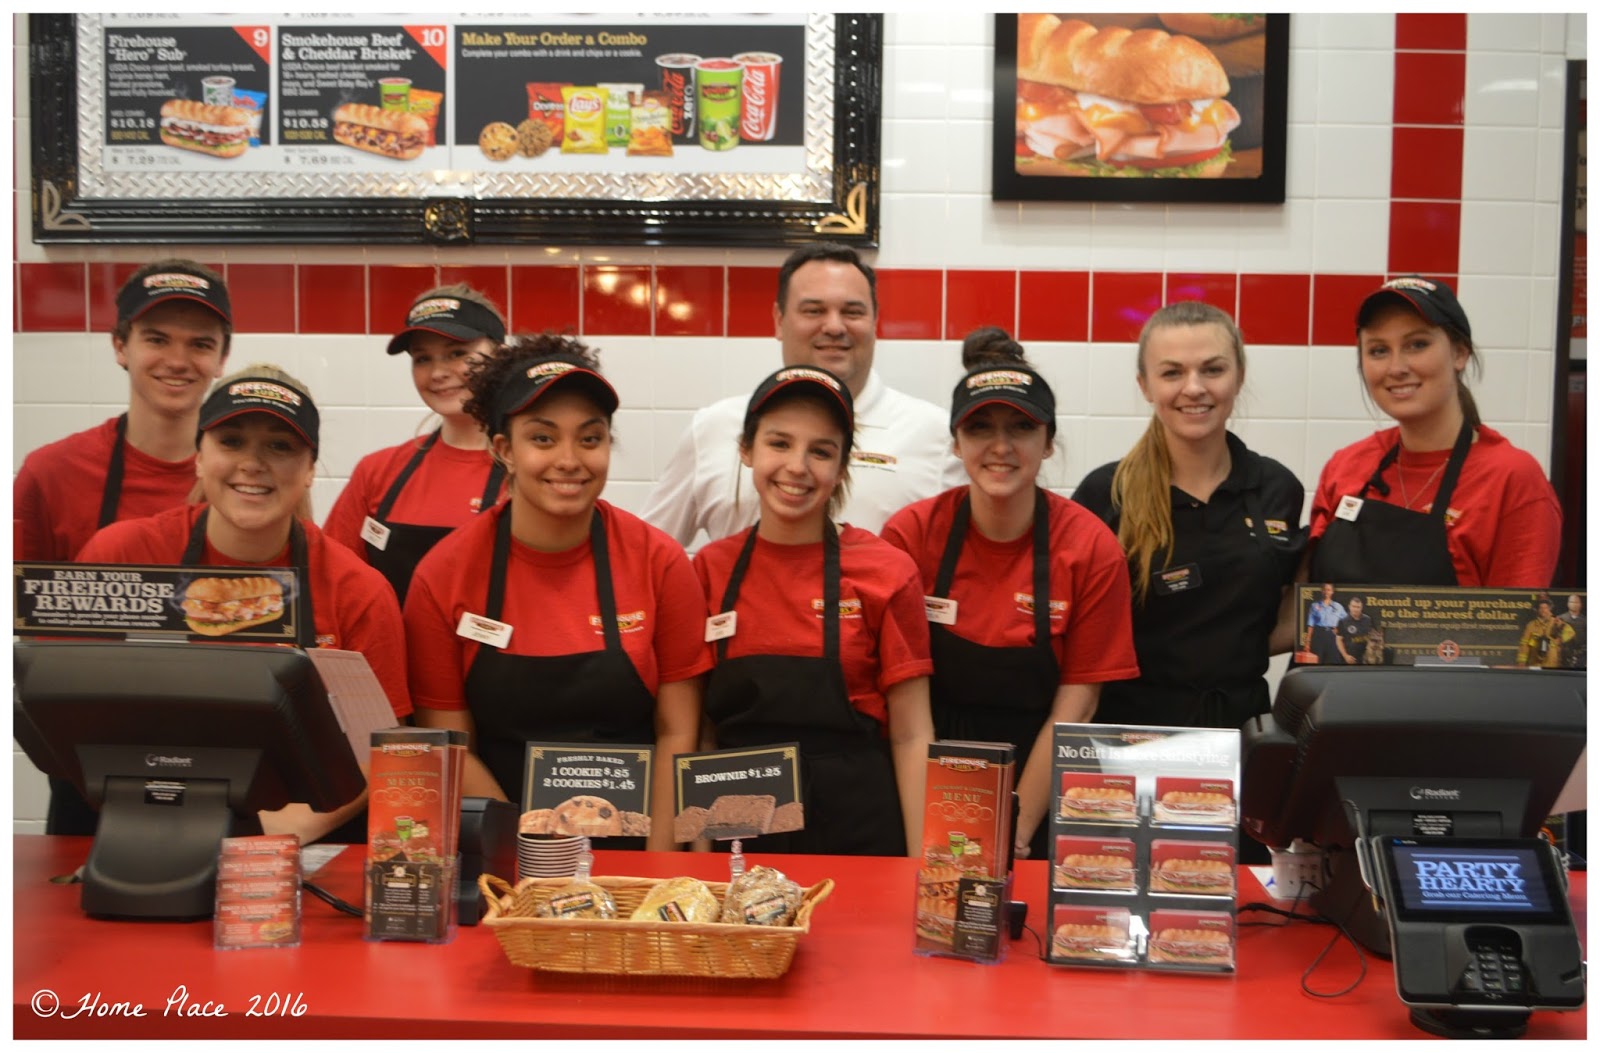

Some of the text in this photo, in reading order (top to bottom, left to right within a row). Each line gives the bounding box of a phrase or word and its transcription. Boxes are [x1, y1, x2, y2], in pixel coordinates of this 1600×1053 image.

[108, 35, 177, 48] Firehouse
[253, 29, 268, 47] 9
[282, 33, 403, 47] Smokehouse Beef
[422, 29, 444, 46] 10
[462, 32, 647, 46] Make Your Order a Combo
[282, 48, 412, 60] & Cheddar Brisket
[742, 68, 766, 138] Coca-Cola
[110, 118, 155, 128] $10.18
[283, 118, 328, 128] $10.58
[54, 570, 142, 583] EARN YOUR
[24, 580, 174, 598] FIREHOUSE
[35, 595, 164, 613] REWARDS
[1366, 596, 1532, 610] Round up your purchase
[1381, 608, 1518, 620] to the nearest dollar
[382, 744, 431, 752] FIREHOUSE
[1058, 746, 1078, 758] No
[1079, 746, 1107, 760] Gift
[1109, 748, 1121, 759] Is
[556, 756, 624, 765] FRESHLY BAKED
[940, 758, 988, 769] FIREHOUSE
[551, 767, 630, 778] 1 COOKIE $.85
[694, 767, 782, 784] BROWNIE $1.25
[387, 778, 426, 786] MENU
[543, 778, 636, 791] 2 COOKIES $1.45
[943, 792, 981, 802] MENU
[1425, 788, 1460, 796] Radiant
[1412, 860, 1521, 878] PARTY
[1416, 876, 1526, 893] HEARTY
[1422, 891, 1444, 899] Grab
[1462, 892, 1500, 901] Catering
